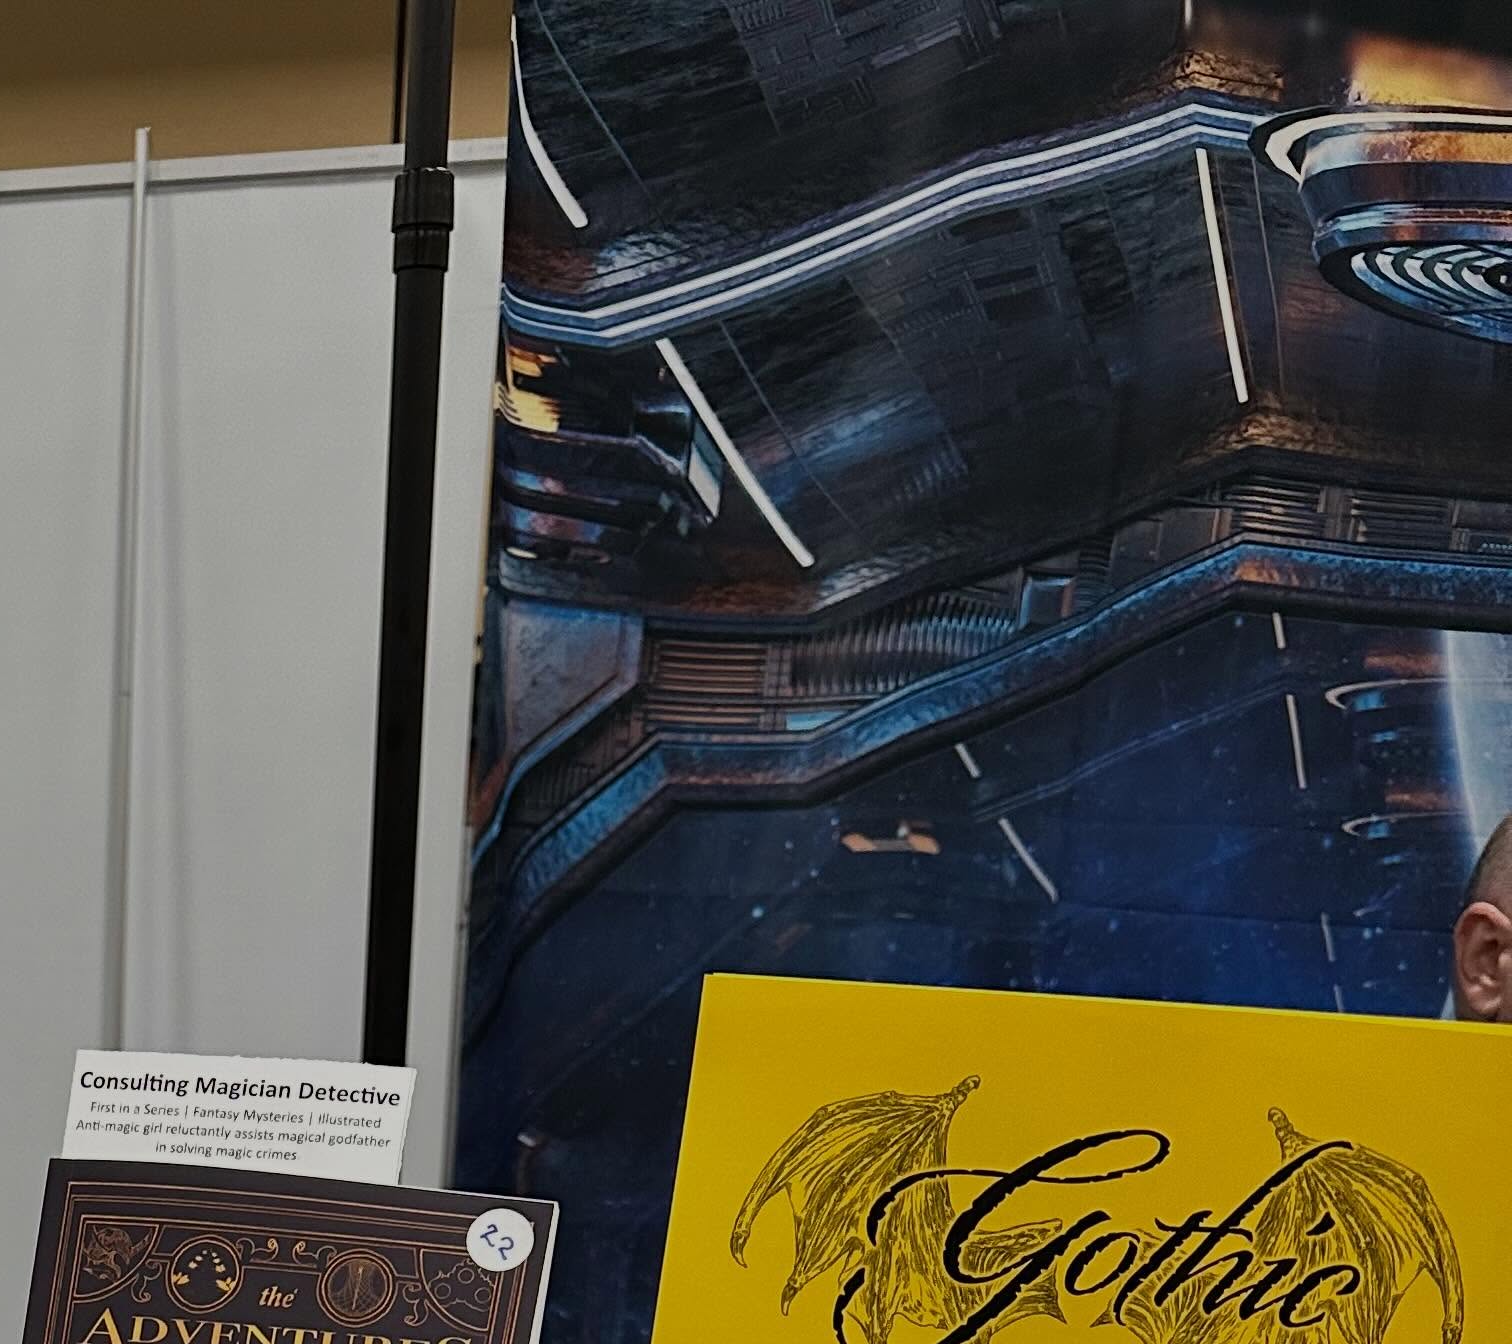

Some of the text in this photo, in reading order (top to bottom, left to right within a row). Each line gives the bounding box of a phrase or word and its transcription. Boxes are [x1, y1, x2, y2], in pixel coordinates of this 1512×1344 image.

[80, 1070, 401, 1107] Consulting Magician Detective
[90, 1101, 117, 1115] First
[119, 1103, 130, 1115] in
[143, 1102, 180, 1117] Series
[192, 1105, 239, 1122] Fantasy
[243, 1108, 304, 1126] Mysteries
[318, 1112, 382, 1129] Illustrated
[76, 1118, 392, 1149] Anti-magic girl reluctantly assists magical godfather
[155, 1141, 298, 1162] in solving magic crimes
[258, 1285, 295, 1309] the
